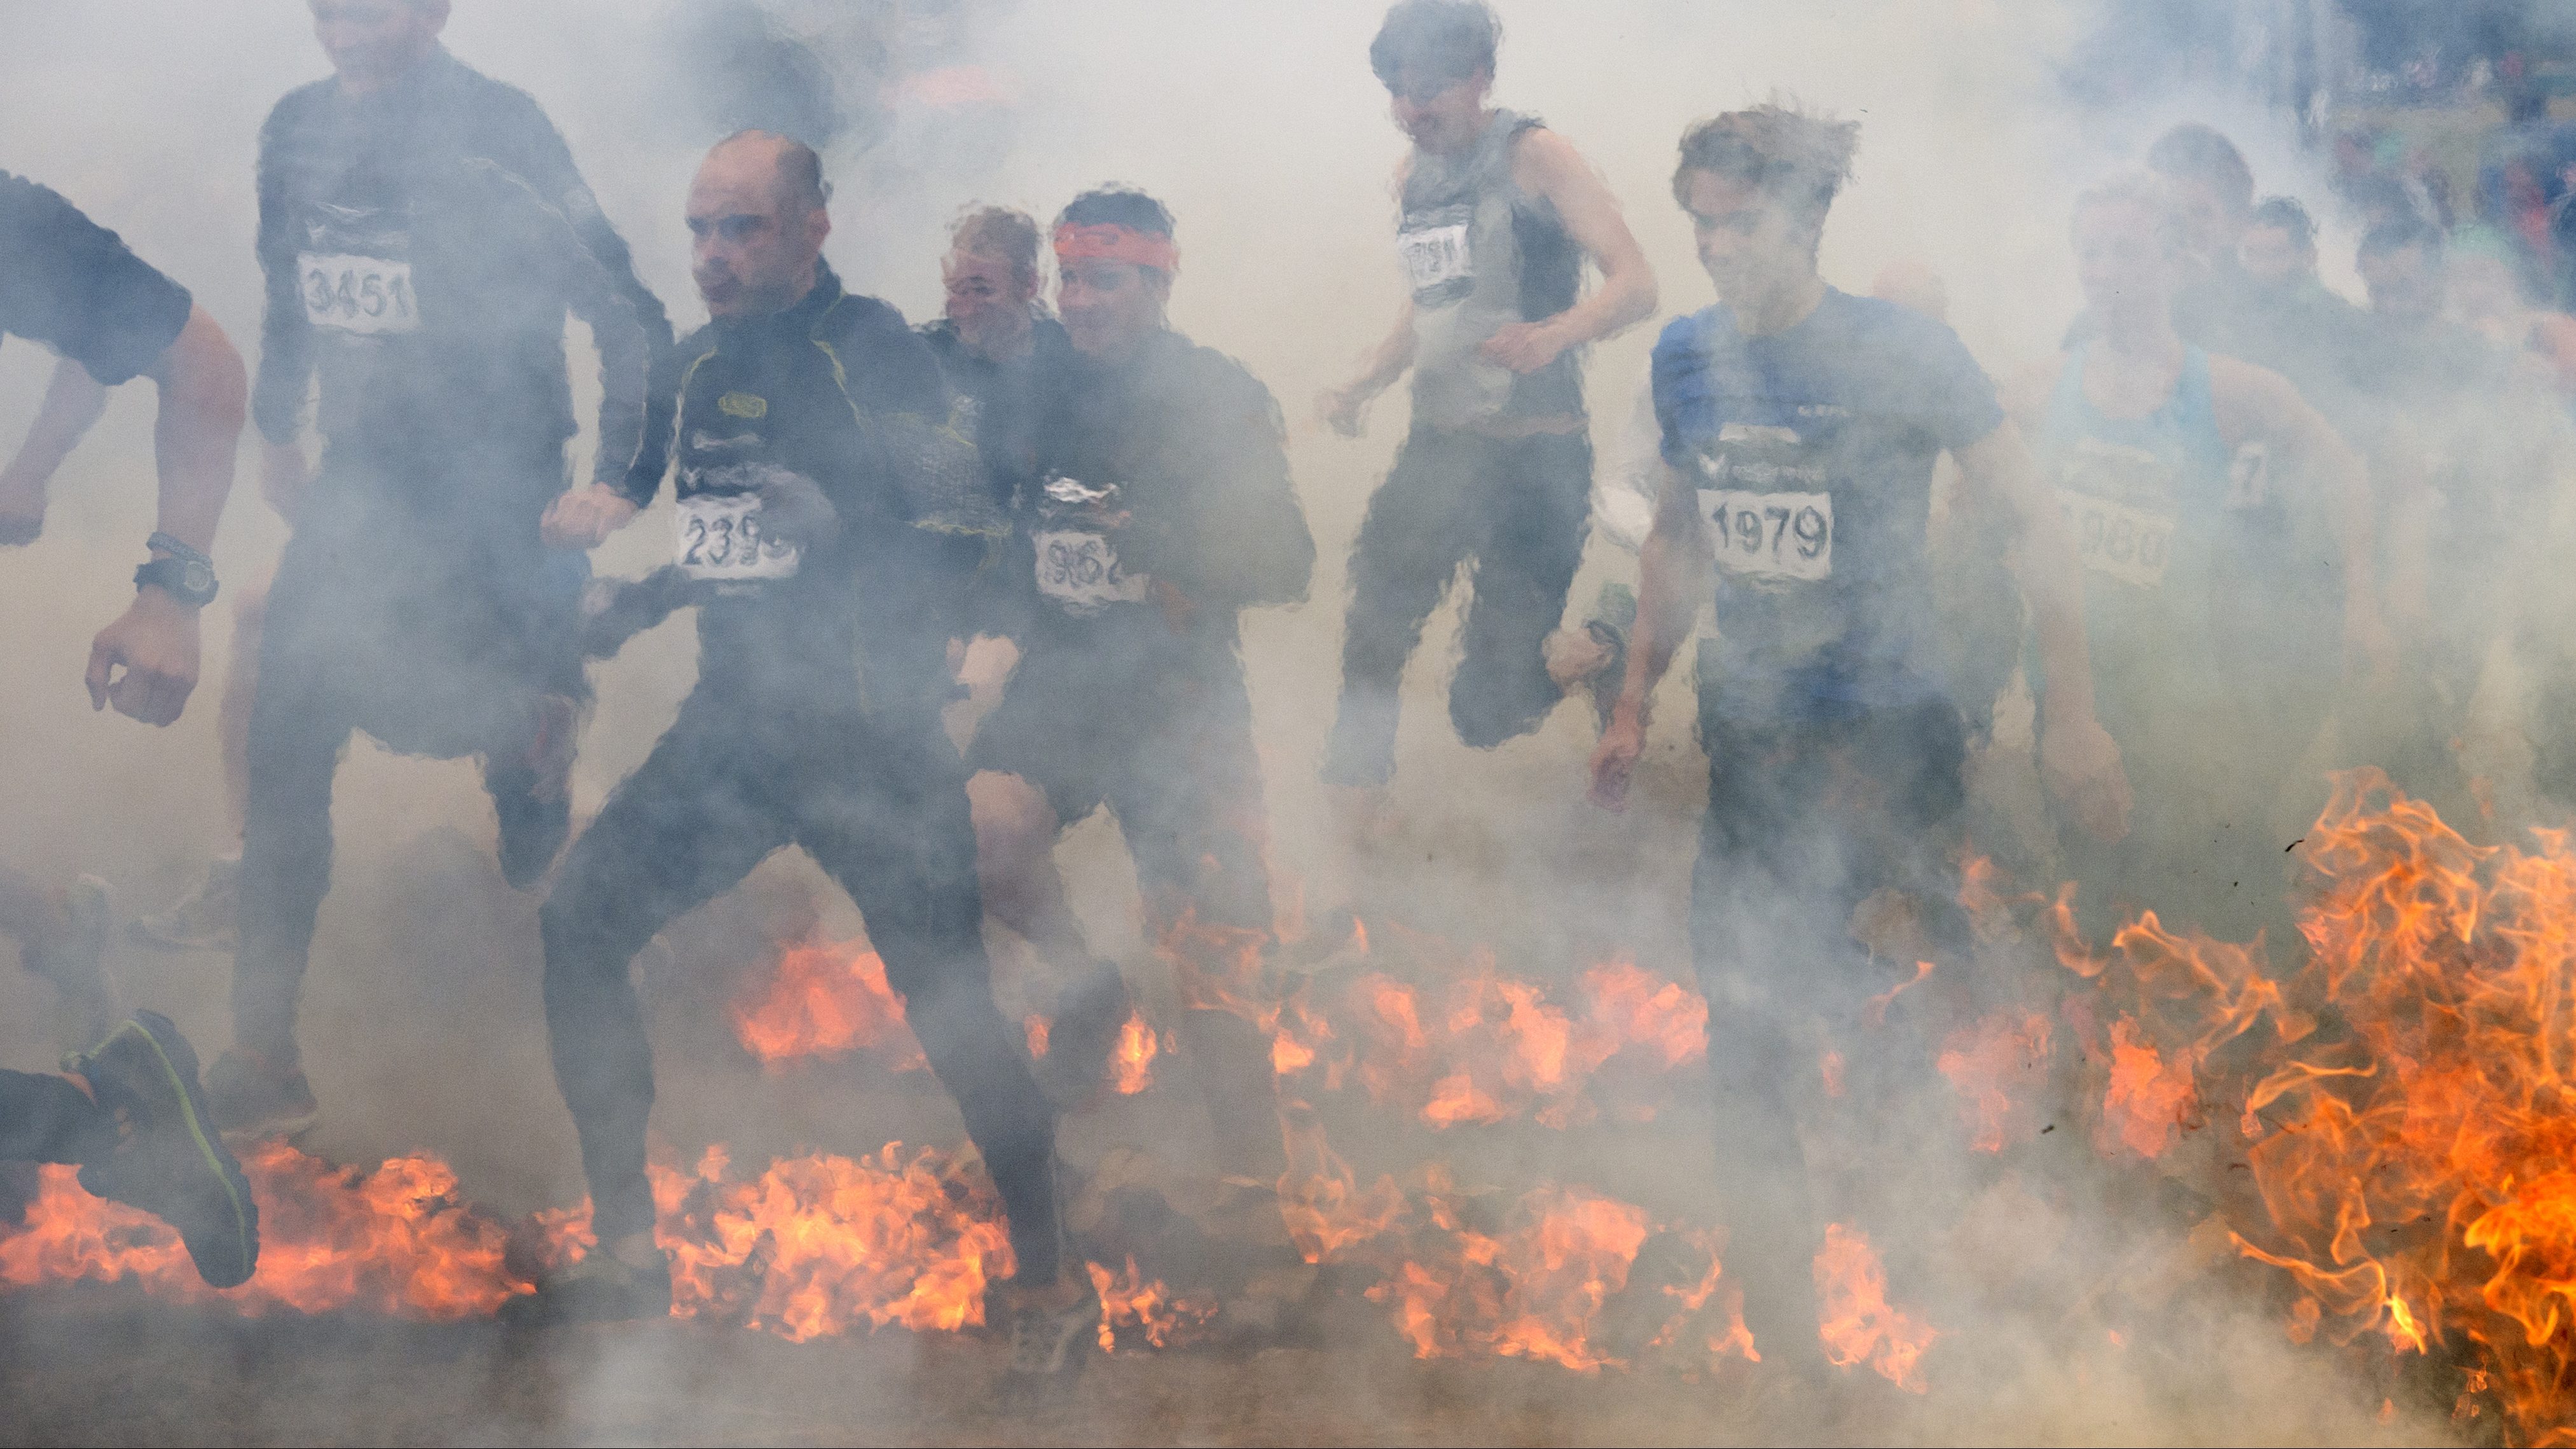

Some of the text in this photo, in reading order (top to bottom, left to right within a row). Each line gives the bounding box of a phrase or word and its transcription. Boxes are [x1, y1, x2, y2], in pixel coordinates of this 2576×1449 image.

[307, 267, 409, 317] 3451
[683, 514, 763, 566] 239
[1711, 503, 1828, 560] 1979
